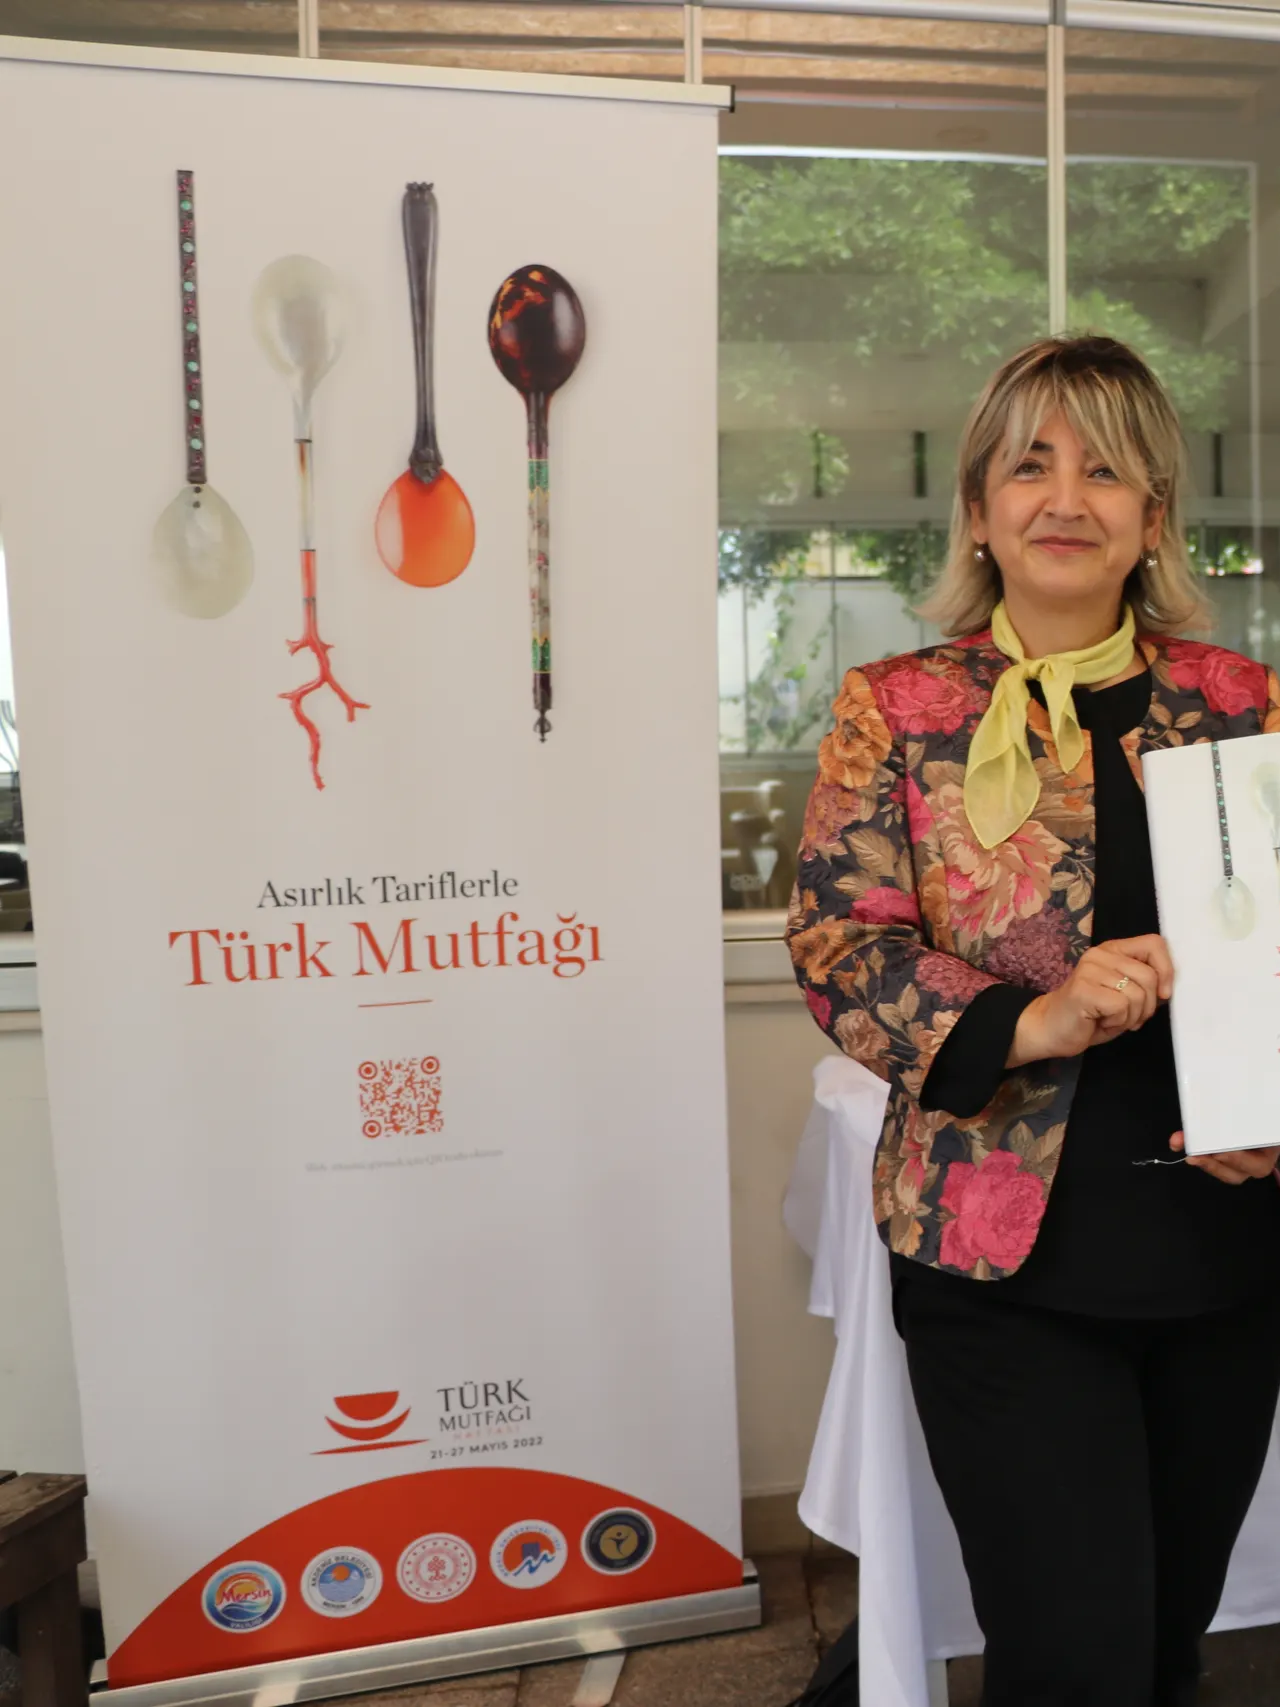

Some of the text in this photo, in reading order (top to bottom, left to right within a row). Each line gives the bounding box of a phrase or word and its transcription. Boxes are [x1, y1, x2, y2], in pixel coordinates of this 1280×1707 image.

[256, 869, 520, 909] Asırlık Tariflerle
[168, 911, 606, 987] Türk Mutfağı
[436, 1378, 530, 1412] TÜRK
[439, 1405, 531, 1431] MUTFAĞI
[430, 1436, 544, 1459] 21-27 MAYIS 2022
[217, 1588, 272, 1606] Mersin
